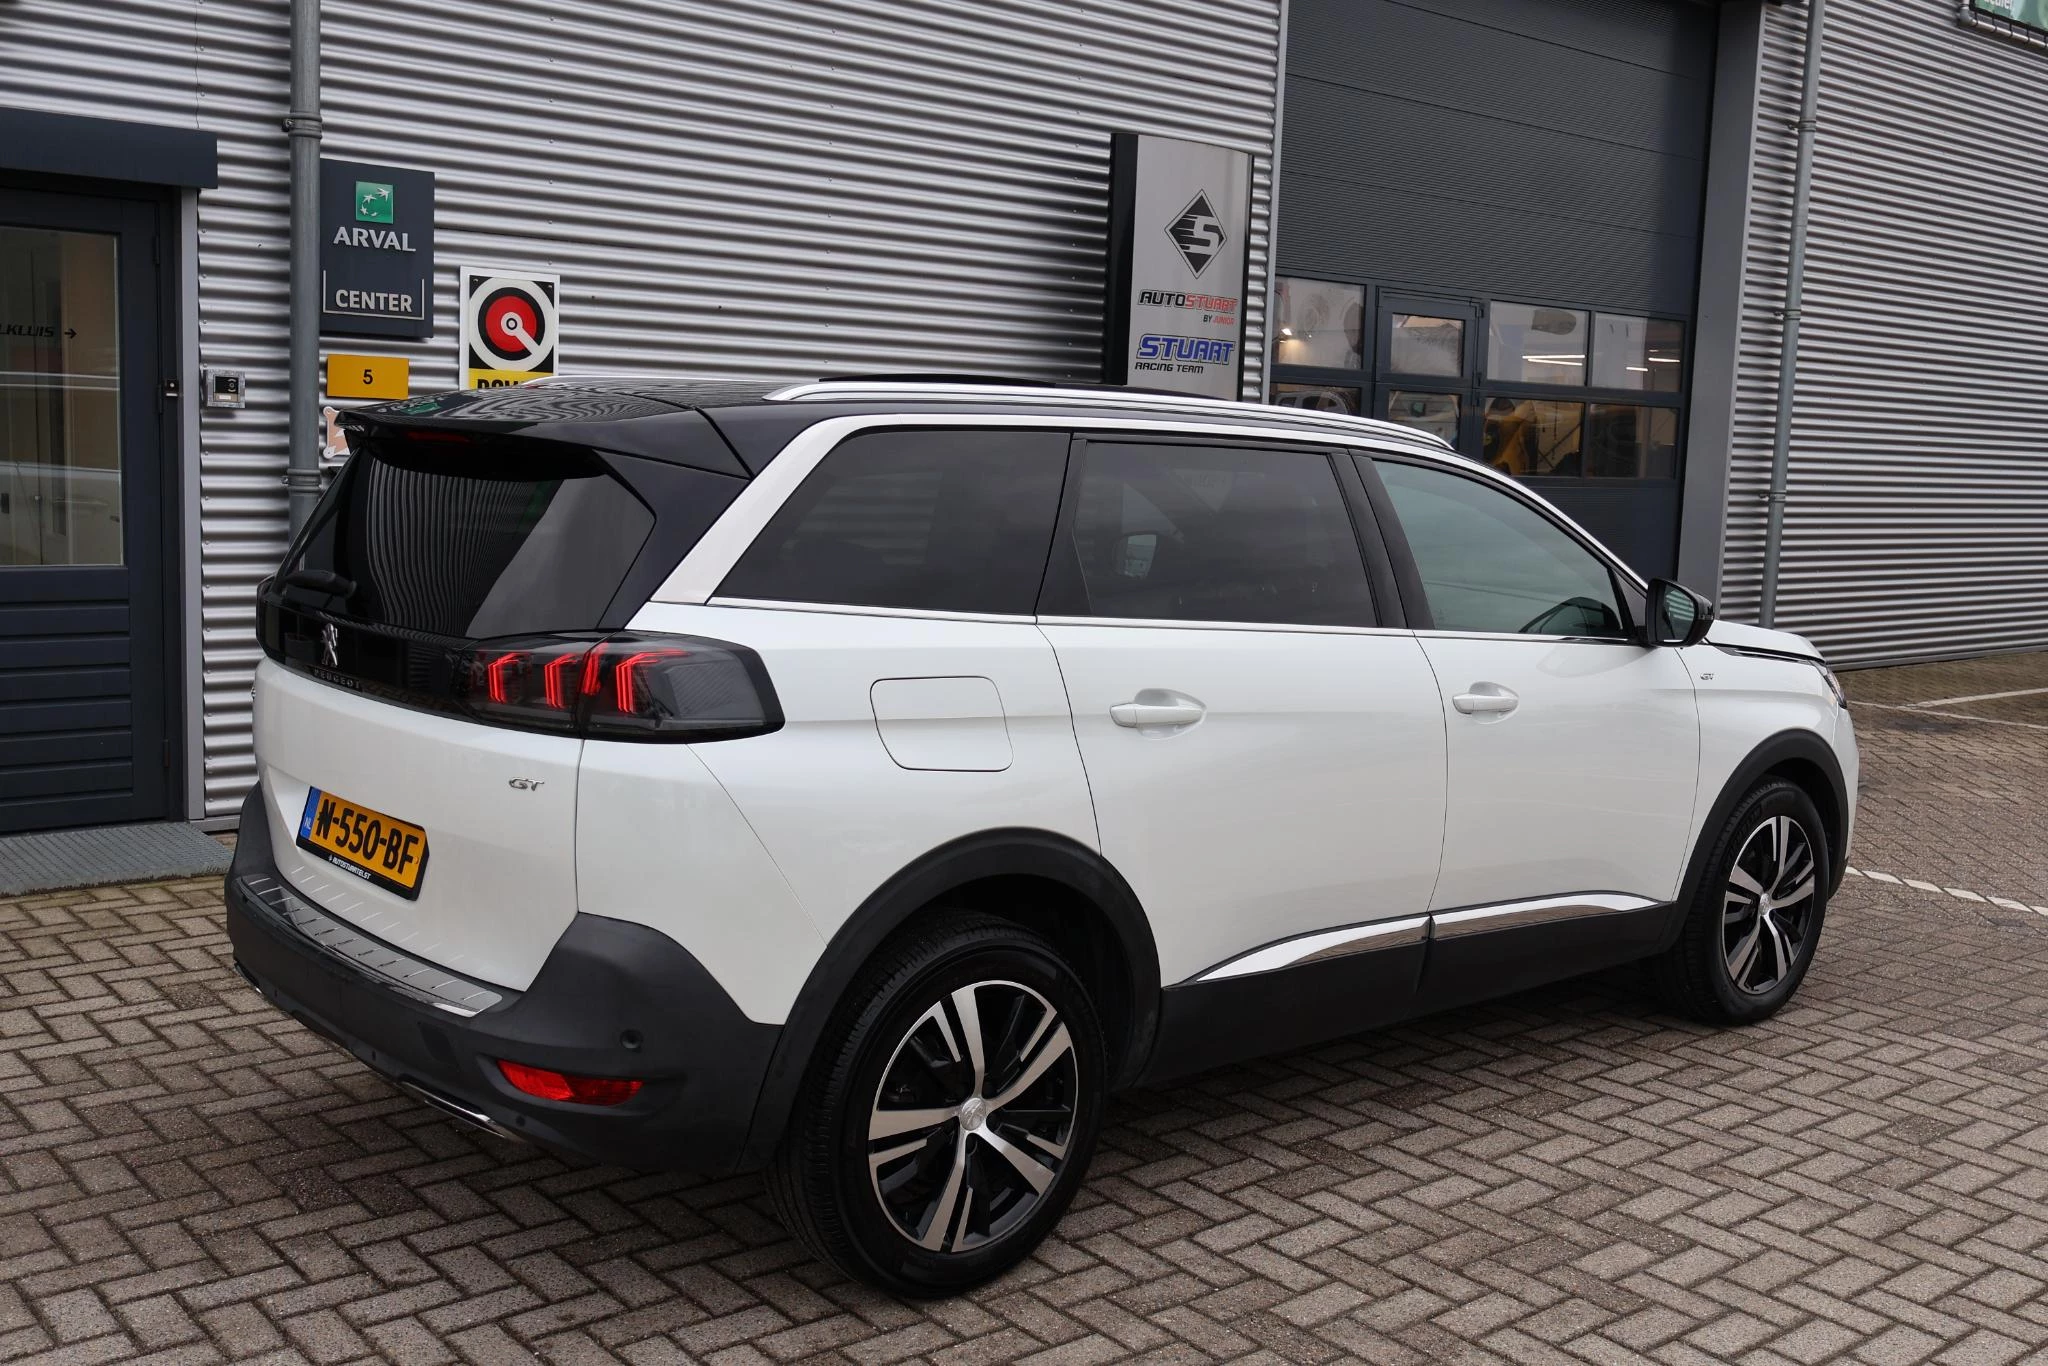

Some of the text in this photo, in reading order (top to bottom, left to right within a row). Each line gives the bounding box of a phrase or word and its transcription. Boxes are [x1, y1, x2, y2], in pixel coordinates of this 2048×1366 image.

[333, 226, 416, 252] ARVAL
[335, 289, 412, 313] CENTER
[1139, 291, 1239, 313] AUTOSTUART
[1203, 314, 1213, 323] BY
[1137, 333, 1236, 365] STUART
[362, 369, 373, 385] 5
[1134, 362, 1204, 374] RACING TEAM
[508, 777, 545, 791] GT
[315, 798, 419, 875] N-550-BF
